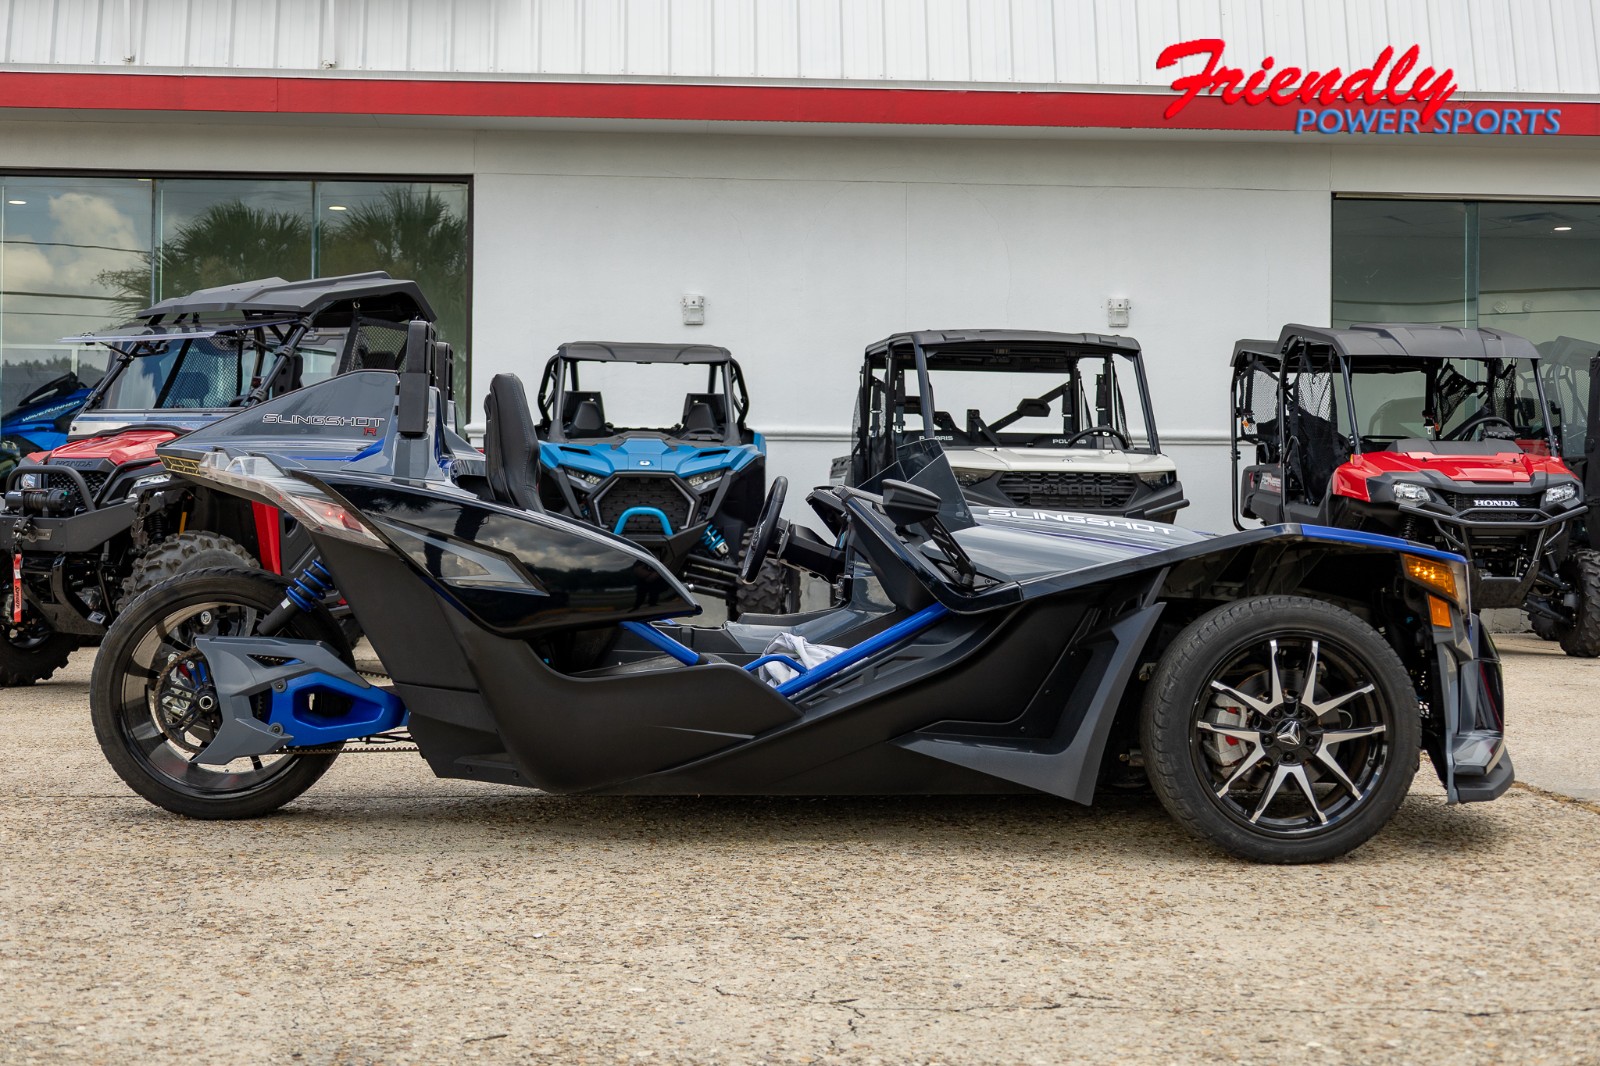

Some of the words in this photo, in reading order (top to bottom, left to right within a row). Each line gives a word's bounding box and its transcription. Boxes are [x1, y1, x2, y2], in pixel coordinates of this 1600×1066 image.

[1156, 38, 1458, 124] Friendly
[1295, 108, 1420, 134] POWER
[1433, 108, 1562, 135] SPORTS
[262, 413, 386, 427] SLINGSHOT
[363, 427, 377, 436] R
[55, 460, 93, 468] HONDA
[1029, 483, 1113, 496] POLARIS
[1473, 499, 1520, 507] HONDA
[986, 508, 1176, 535] SLINGSHOT
